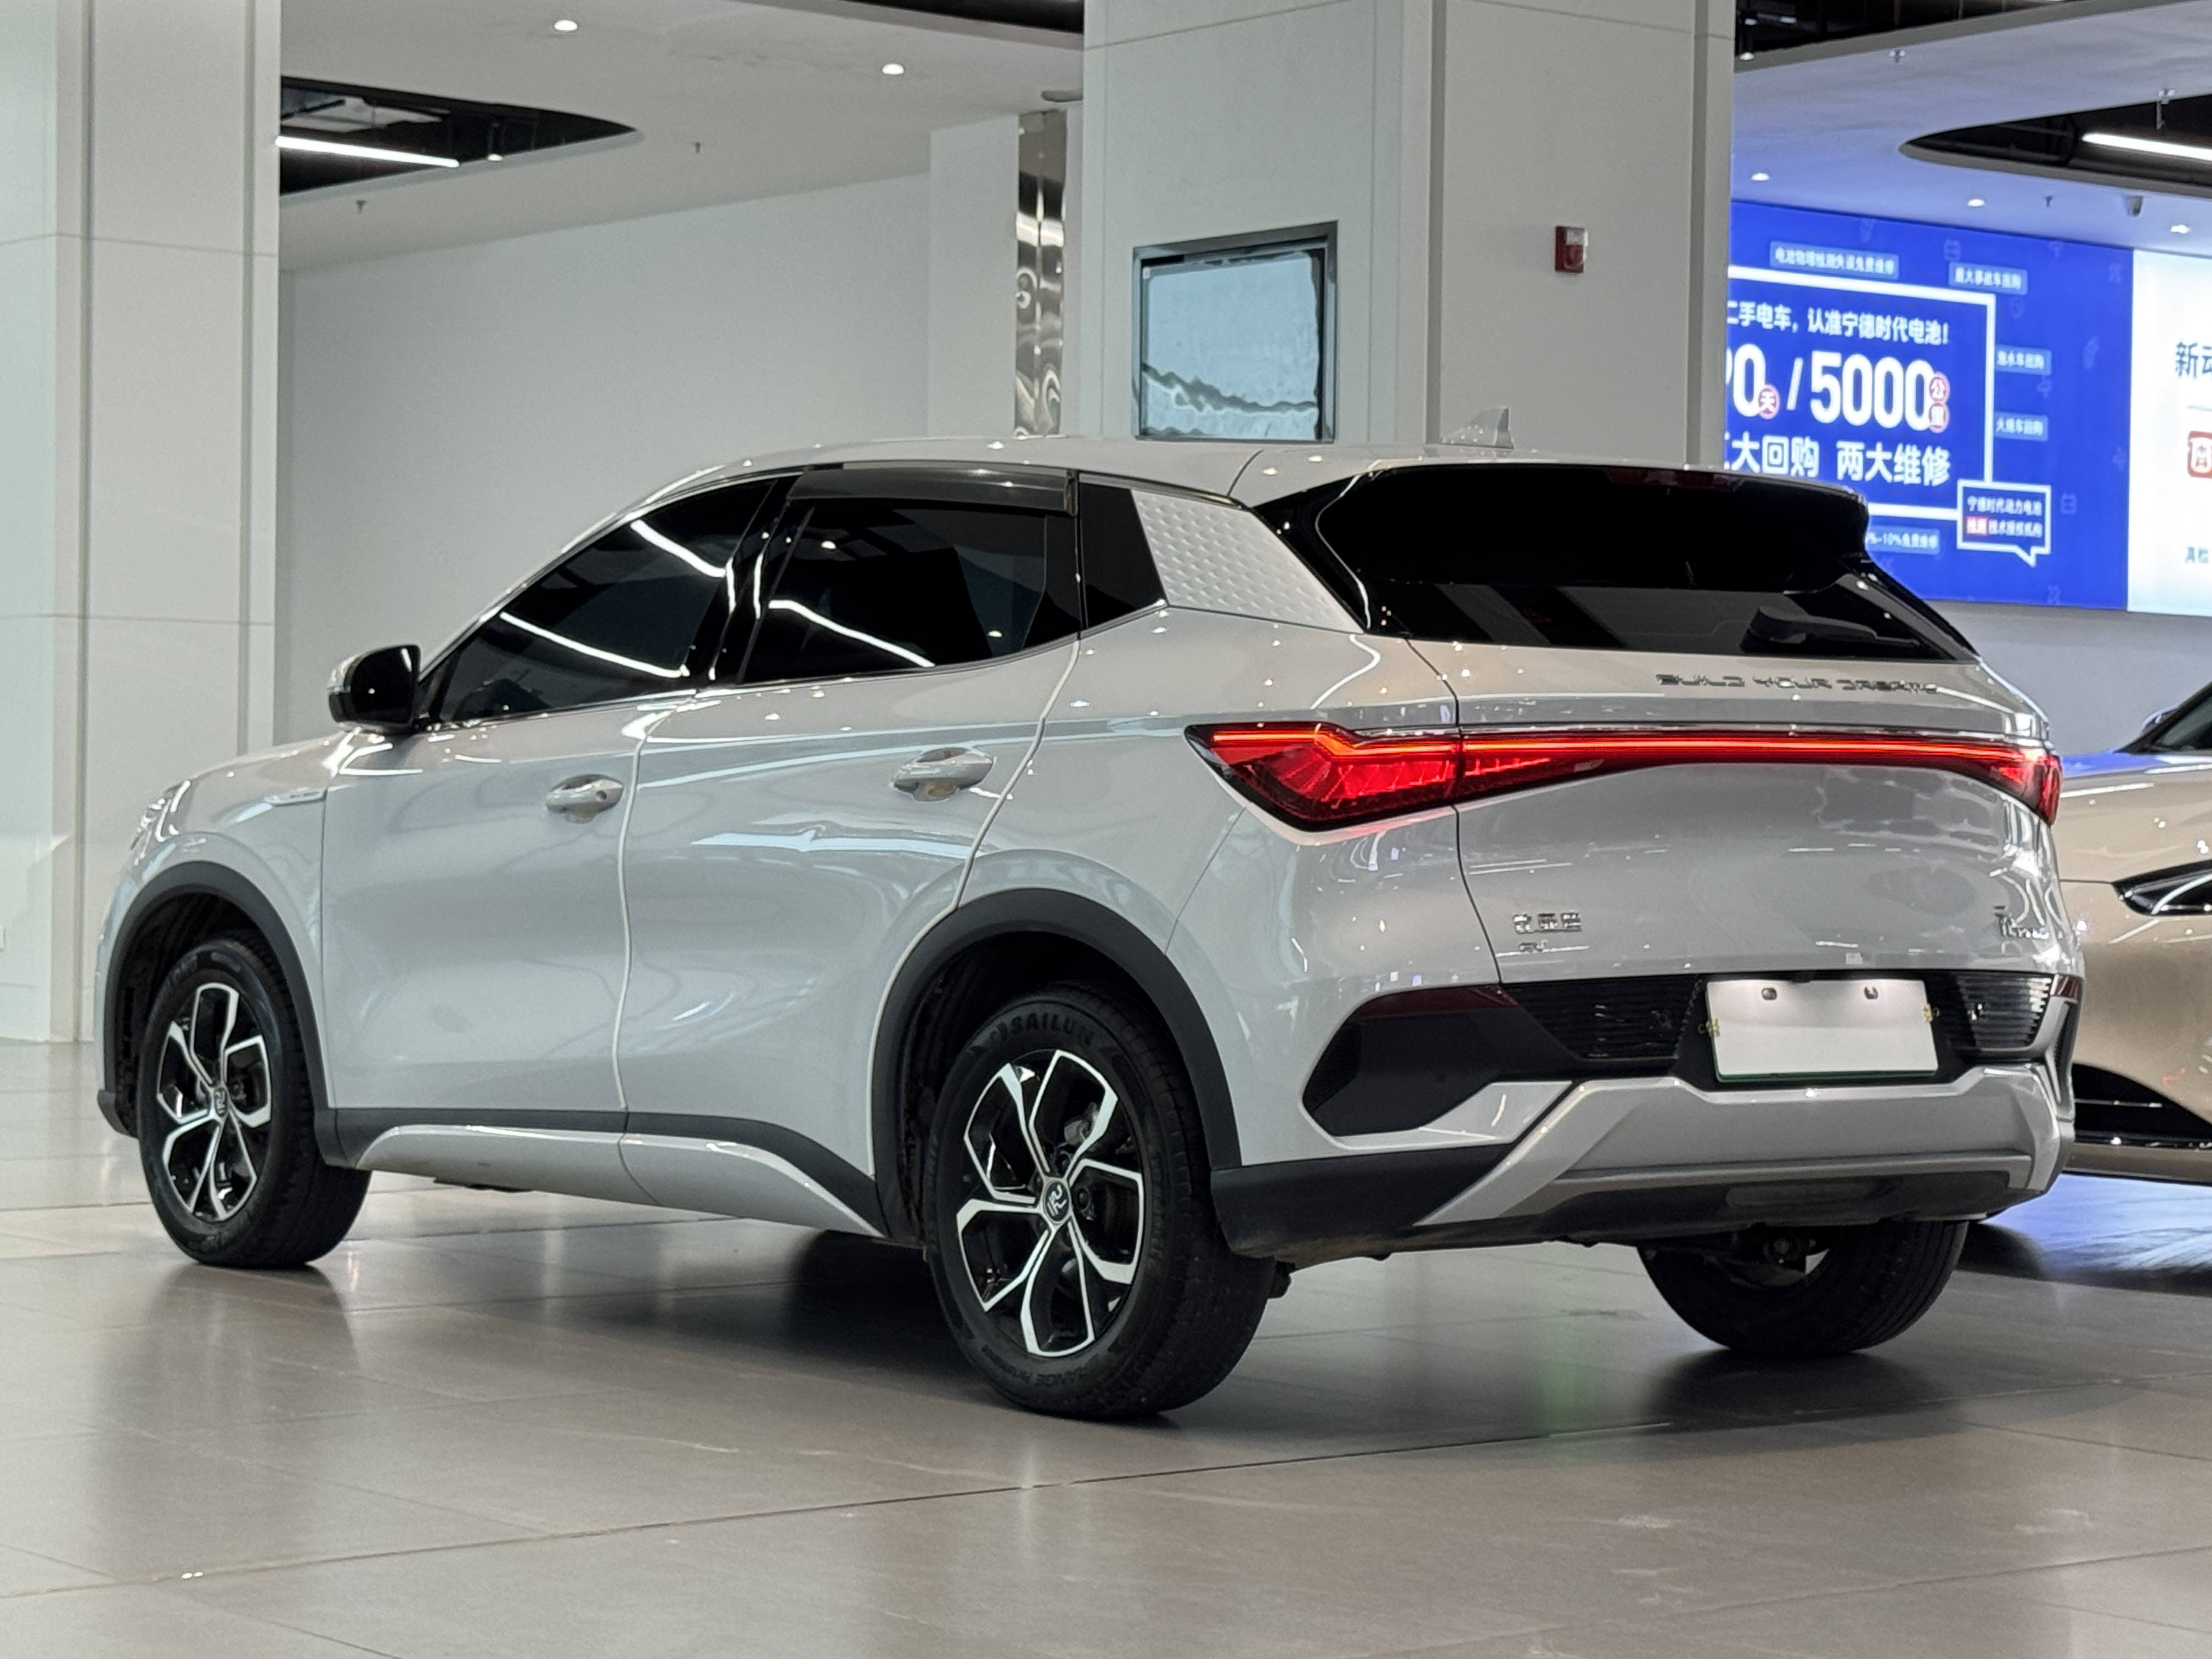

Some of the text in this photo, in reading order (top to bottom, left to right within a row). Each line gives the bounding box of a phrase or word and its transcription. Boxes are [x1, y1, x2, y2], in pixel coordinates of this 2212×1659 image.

[1724, 431, 1951, 487] 大回购 两大维修
[1656, 674, 1746, 687] BUILD
[1752, 676, 1833, 690] YOUR
